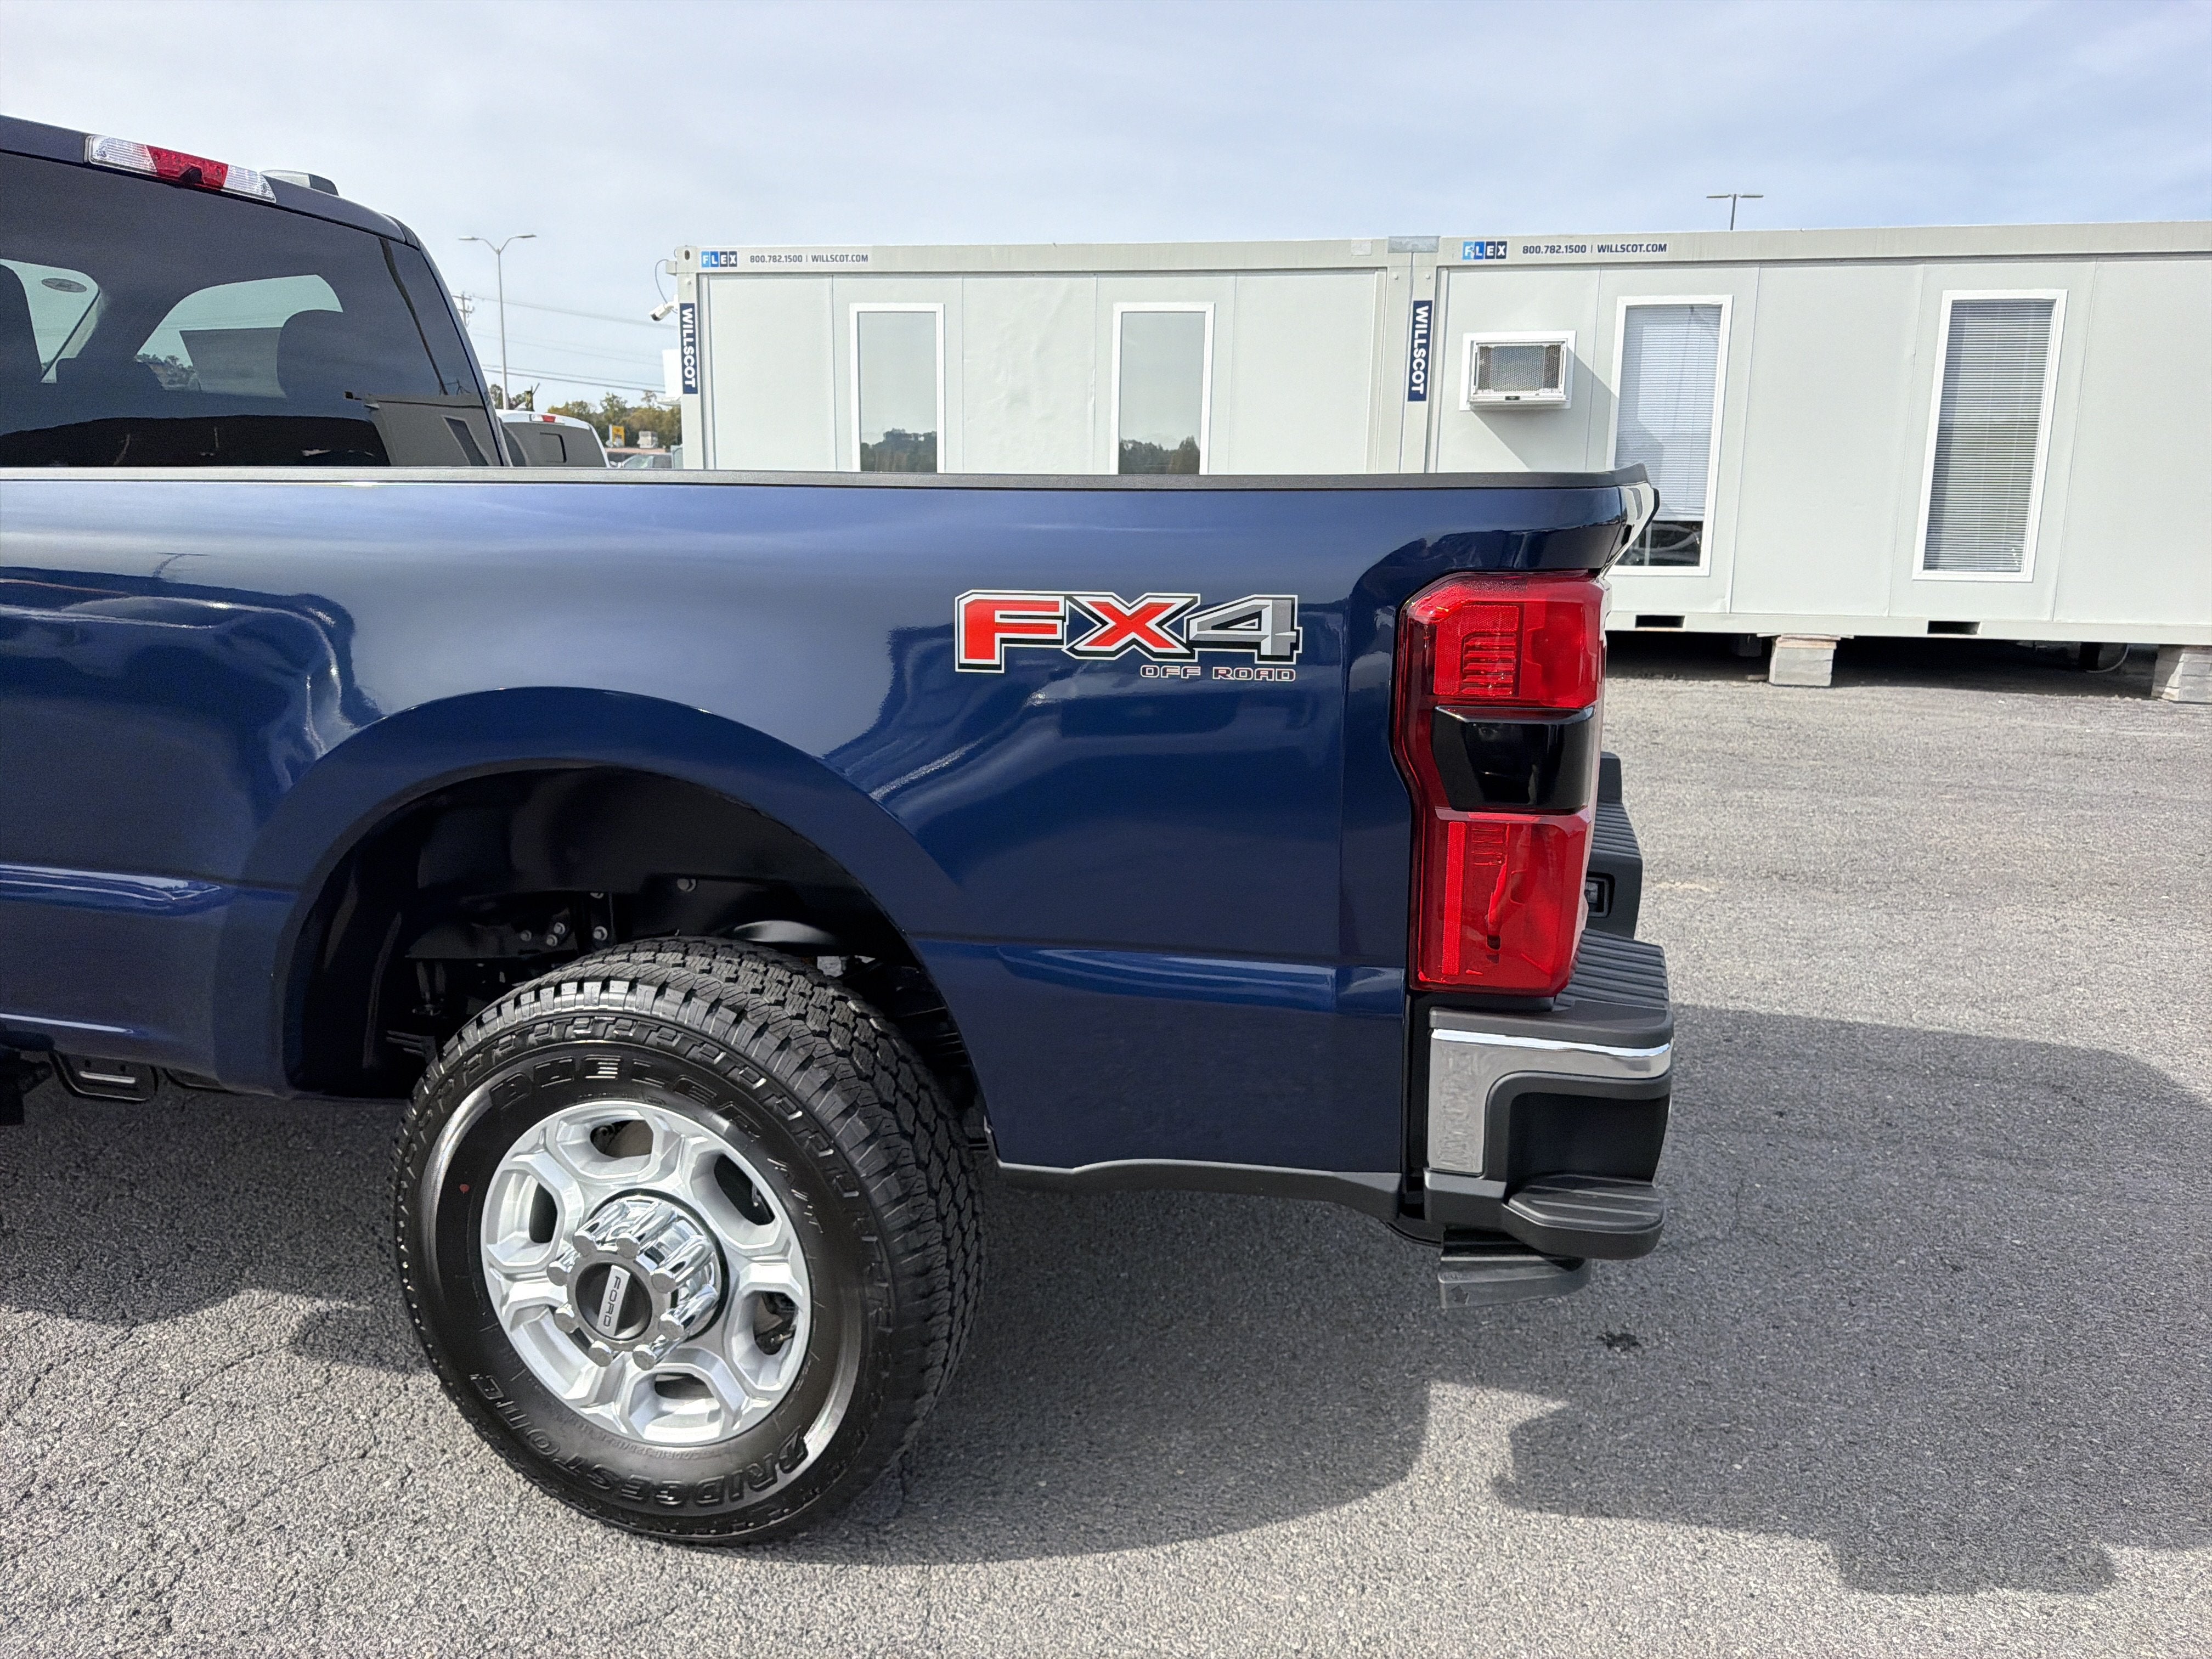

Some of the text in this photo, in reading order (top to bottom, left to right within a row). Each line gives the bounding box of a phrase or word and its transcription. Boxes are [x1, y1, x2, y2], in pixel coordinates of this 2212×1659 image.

[702, 253, 737, 266] FLEX
[750, 254, 868, 263] 800.782.1500 WILLSCOT.COM
[1464, 244, 1506, 257] FLEX
[1522, 244, 1667, 254] 800.782.1500 WILLSCOT.COM
[681, 308, 696, 388] WILLSCOT
[1410, 306, 1429, 394] WILLSCOT
[955, 590, 1302, 673] FX4
[1140, 664, 1296, 681] OFF ROAD
[603, 1276, 621, 1327] FORD
[469, 1373, 809, 1505] BRIDGESTONE
